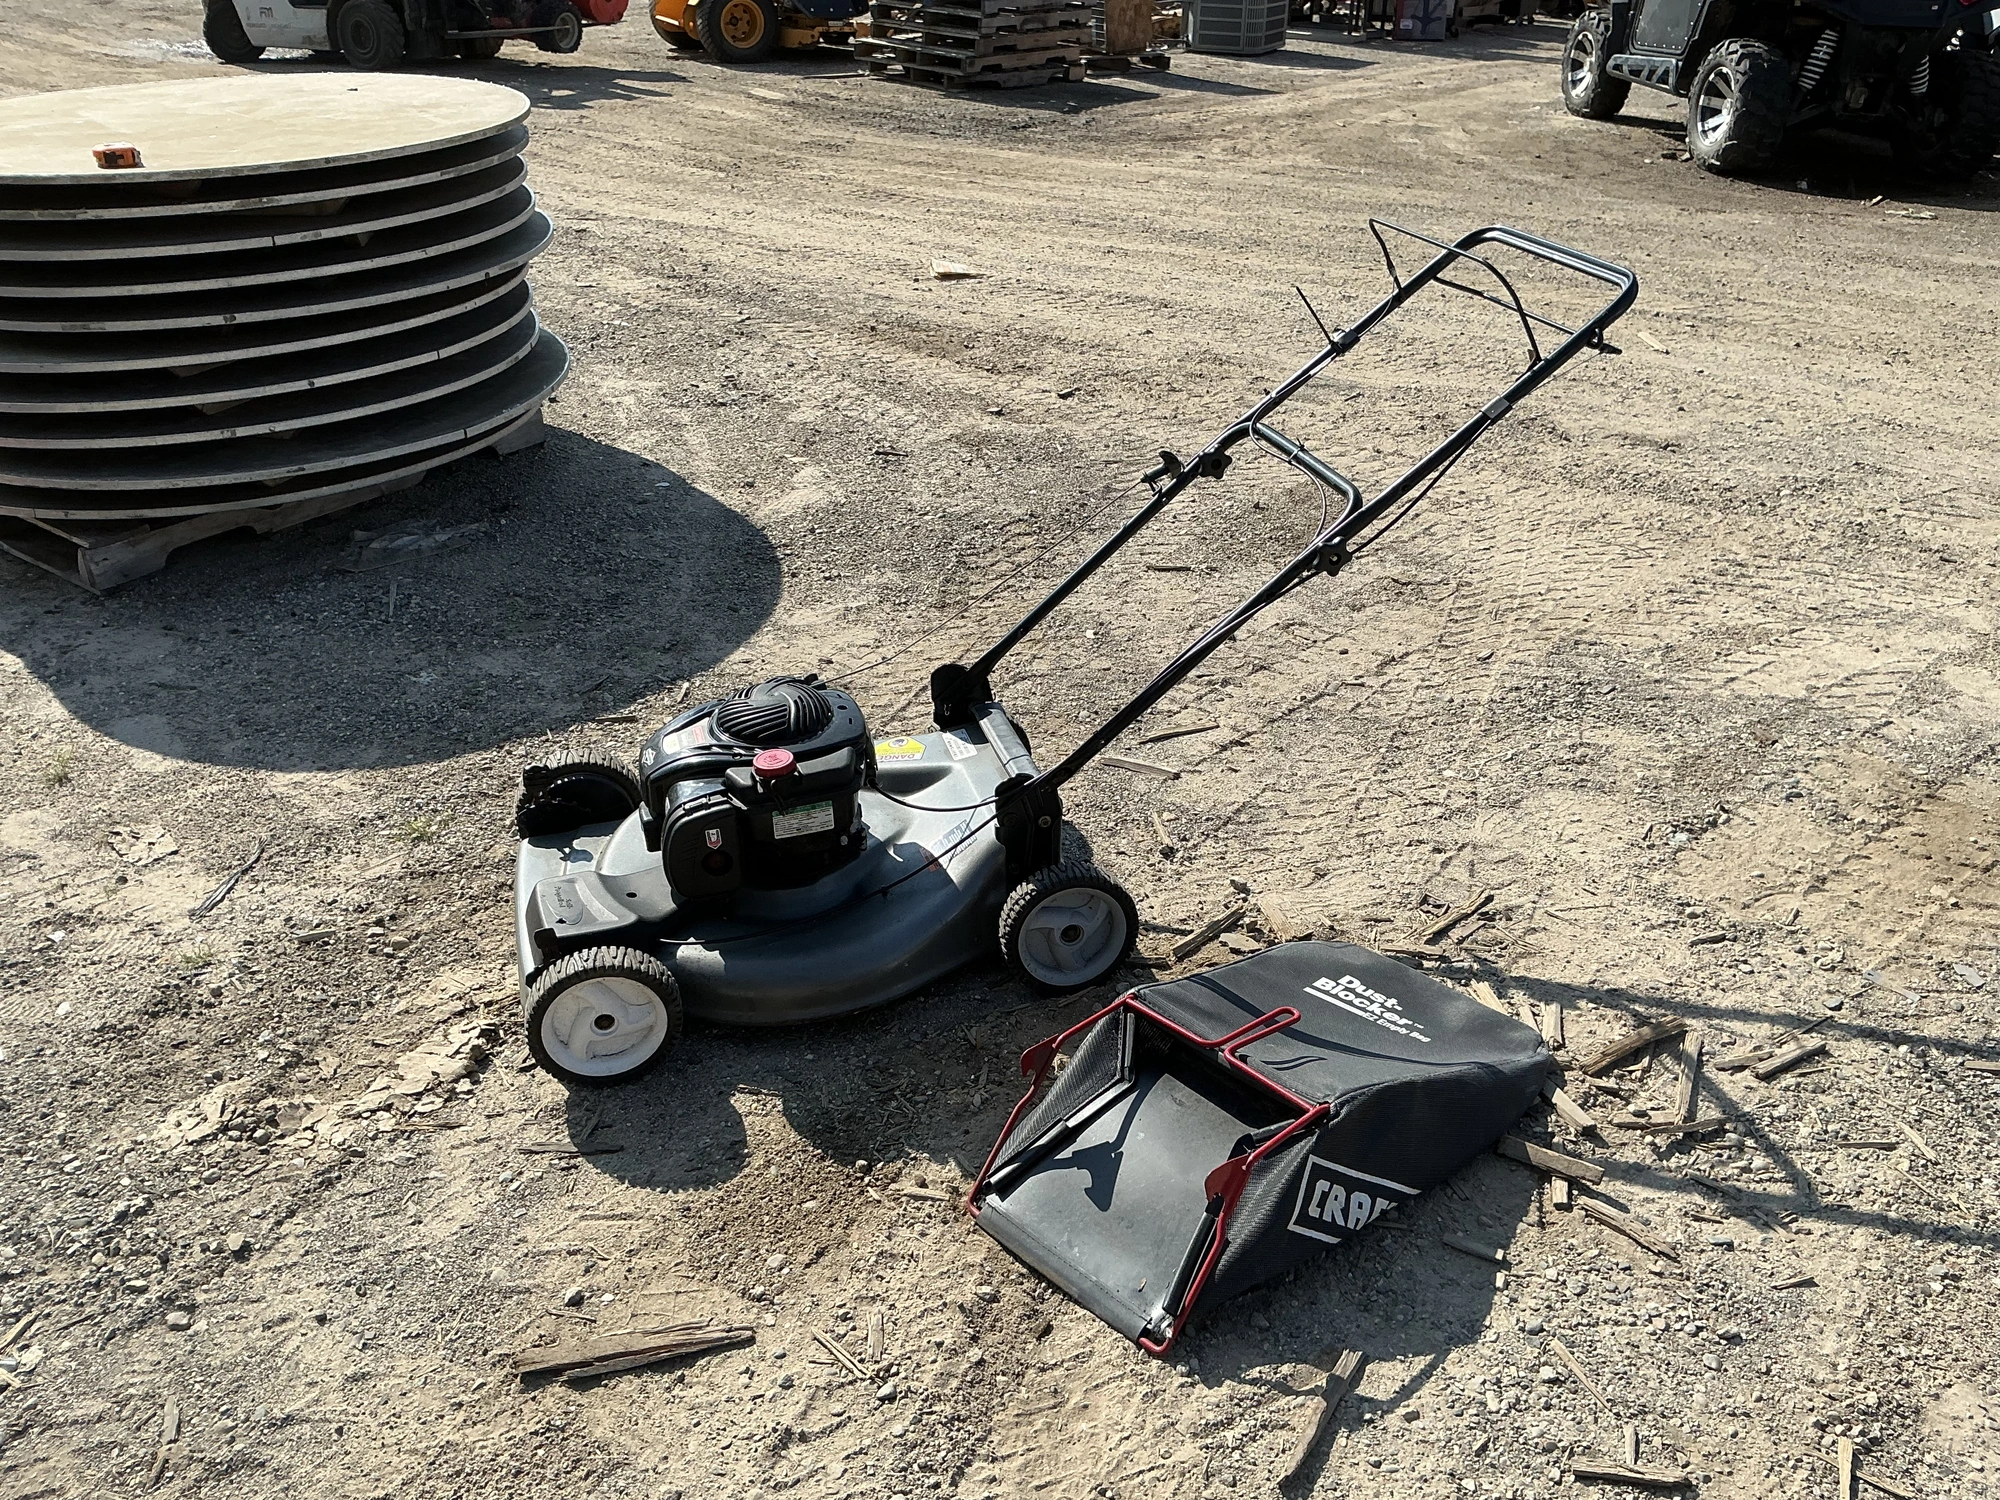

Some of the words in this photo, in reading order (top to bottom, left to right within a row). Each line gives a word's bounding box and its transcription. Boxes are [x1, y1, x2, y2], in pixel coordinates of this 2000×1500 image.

[879, 753, 916, 761] DANGE
[1336, 974, 1403, 1011] Dust-
[1364, 1011, 1380, 1022] EZ
[1376, 1018, 1411, 1035] Empty
[1409, 1031, 1432, 1043] Bag
